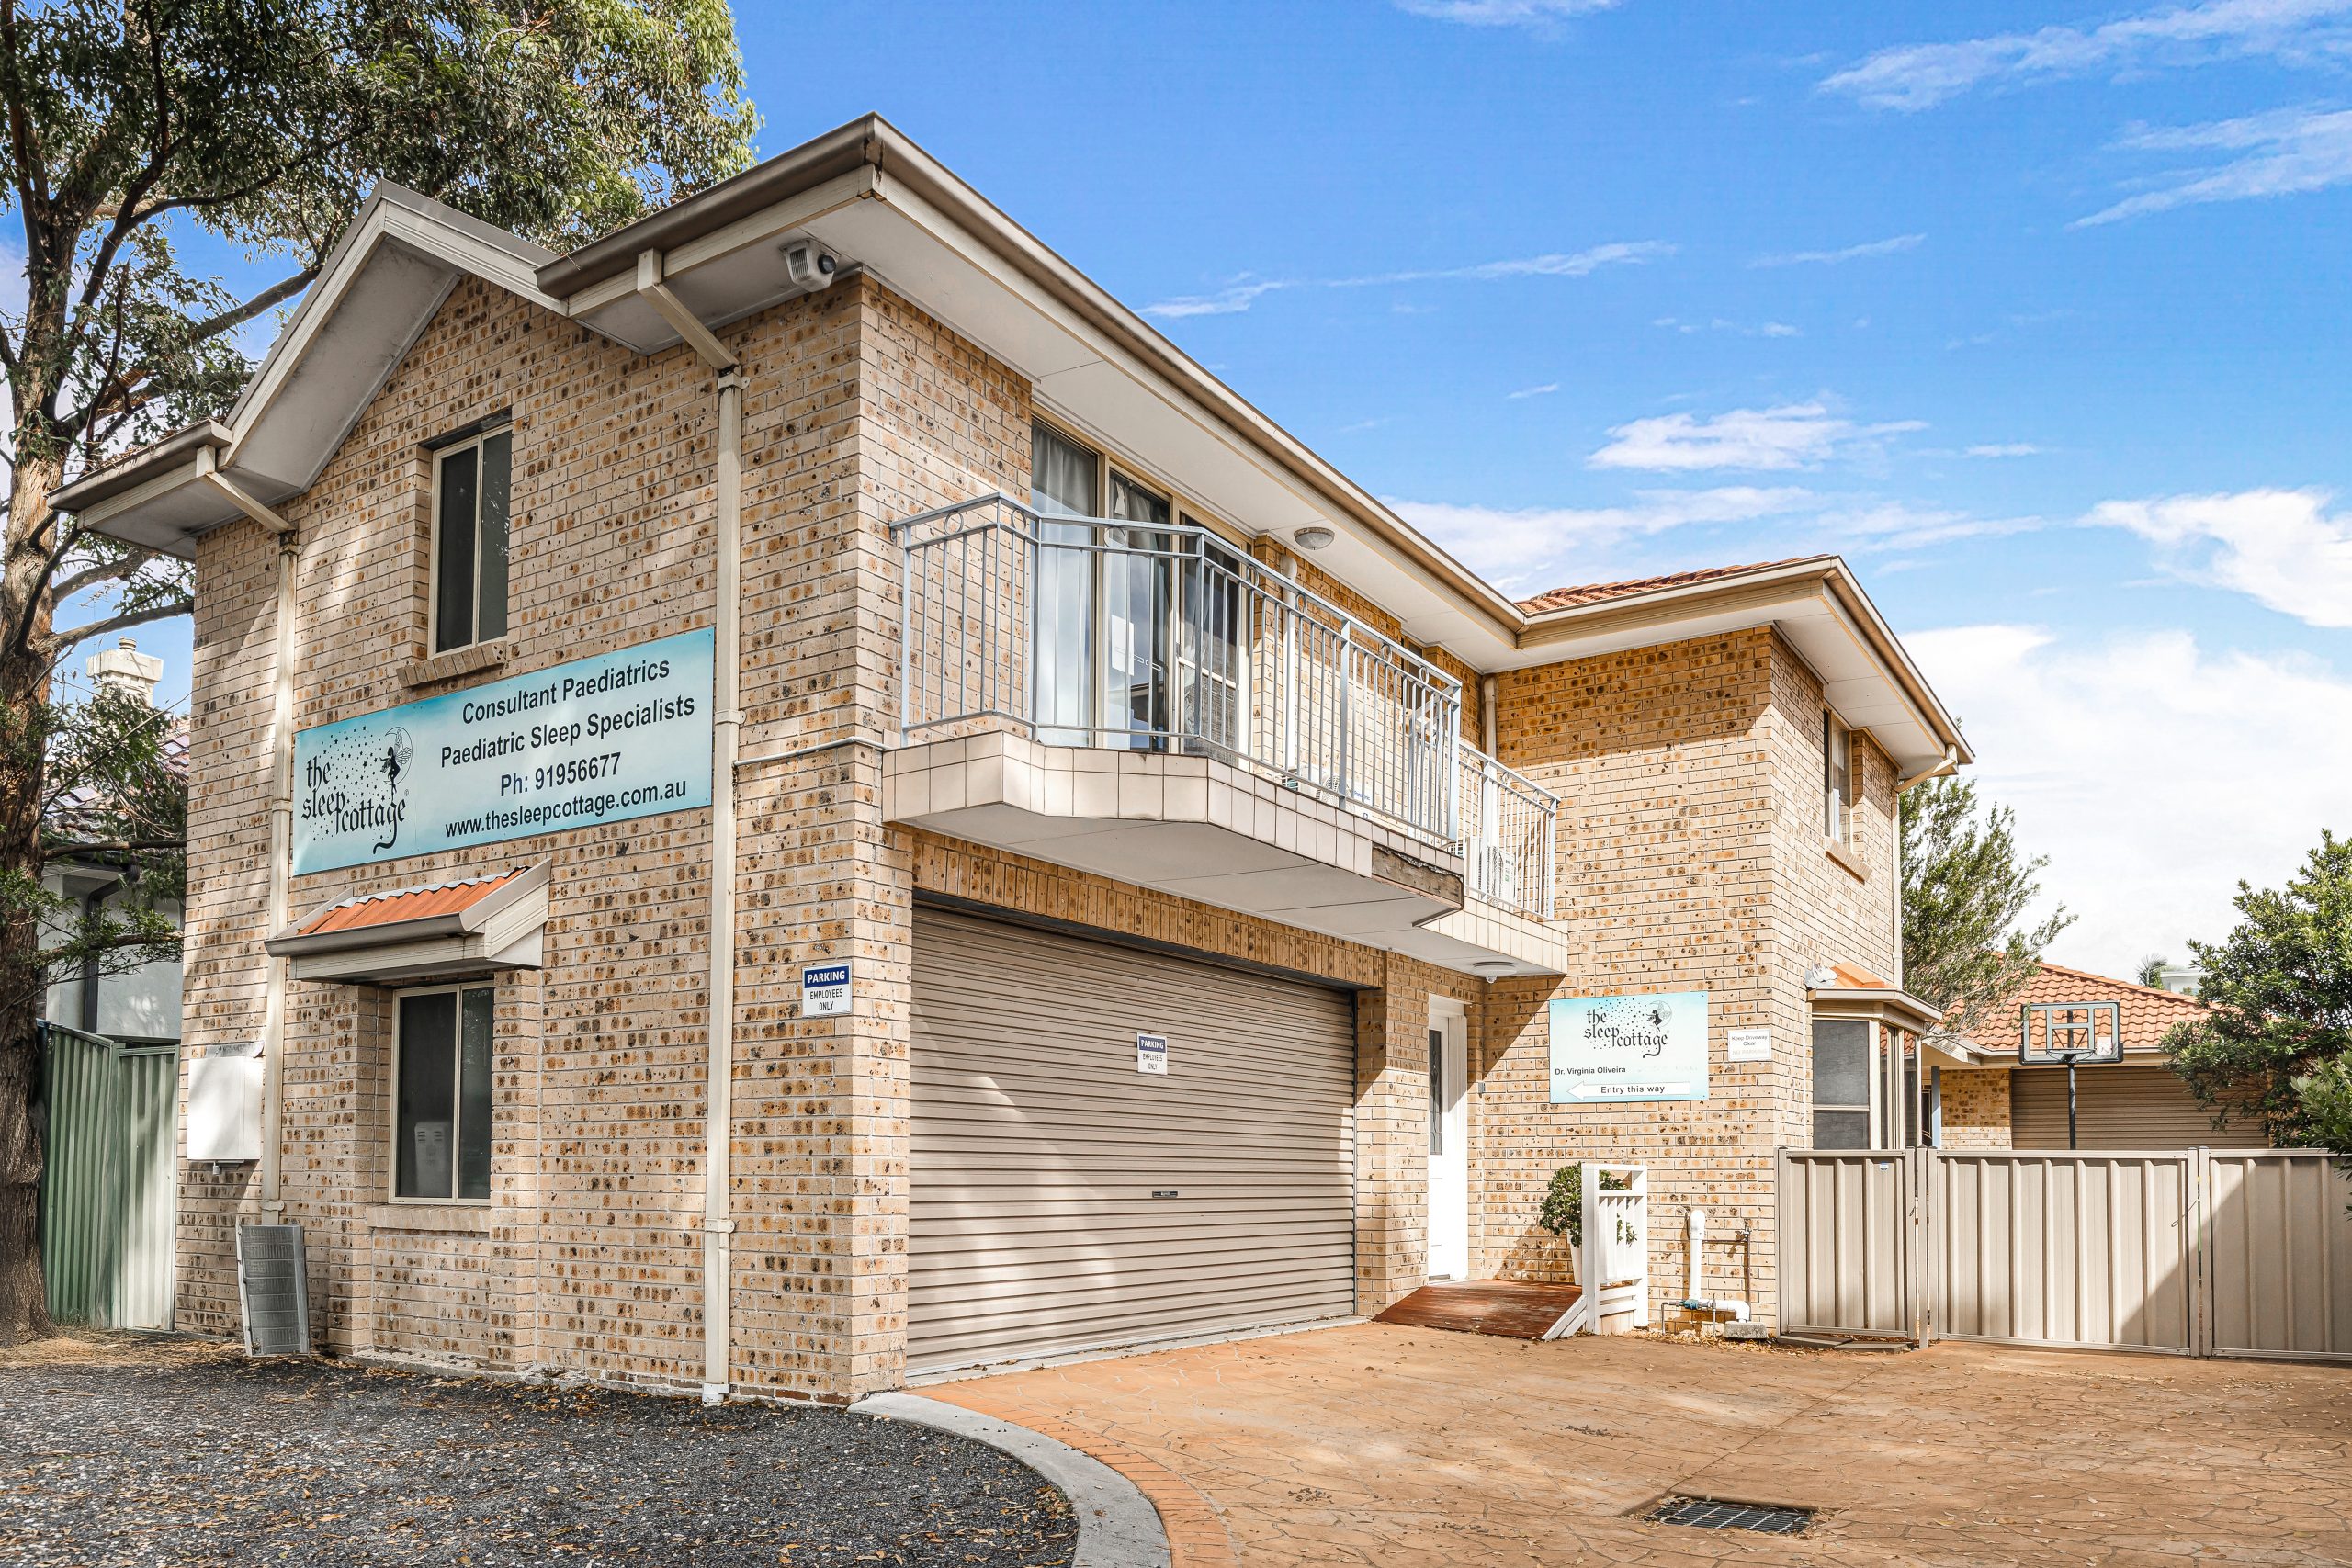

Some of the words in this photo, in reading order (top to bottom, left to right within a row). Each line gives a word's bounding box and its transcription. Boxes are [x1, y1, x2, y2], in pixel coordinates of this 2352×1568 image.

[462, 683, 557, 725] Consultant
[562, 660, 671, 701] Paediatrics
[441, 732, 525, 768] Paediatric
[530, 722, 582, 747] Sleep
[587, 694, 695, 739] Specialists
[306, 755, 332, 792] the
[501, 772, 529, 797] Ph:
[535, 751, 621, 790] 91956677
[445, 780, 687, 838] www.thesleepcottage.com.au
[301, 787, 345, 835] sleep
[341, 797, 406, 854] cottage
[808, 970, 845, 984] PARKING
[810, 988, 843, 999] EMPLOYEES
[819, 1001, 834, 1010] ONLY
[1587, 1009, 1607, 1025] the
[1141, 1040, 1164, 1049] PARKING
[1583, 1023, 1620, 1047] sleep
[1617, 1032, 1668, 1058] cottage
[1143, 1053, 1163, 1062] EMPLOYEES
[1567, 1067, 1595, 1076] Virginia
[1600, 1085, 1624, 1095] Entry
[1627, 1084, 1644, 1093] this
[1647, 1084, 1666, 1093] way
